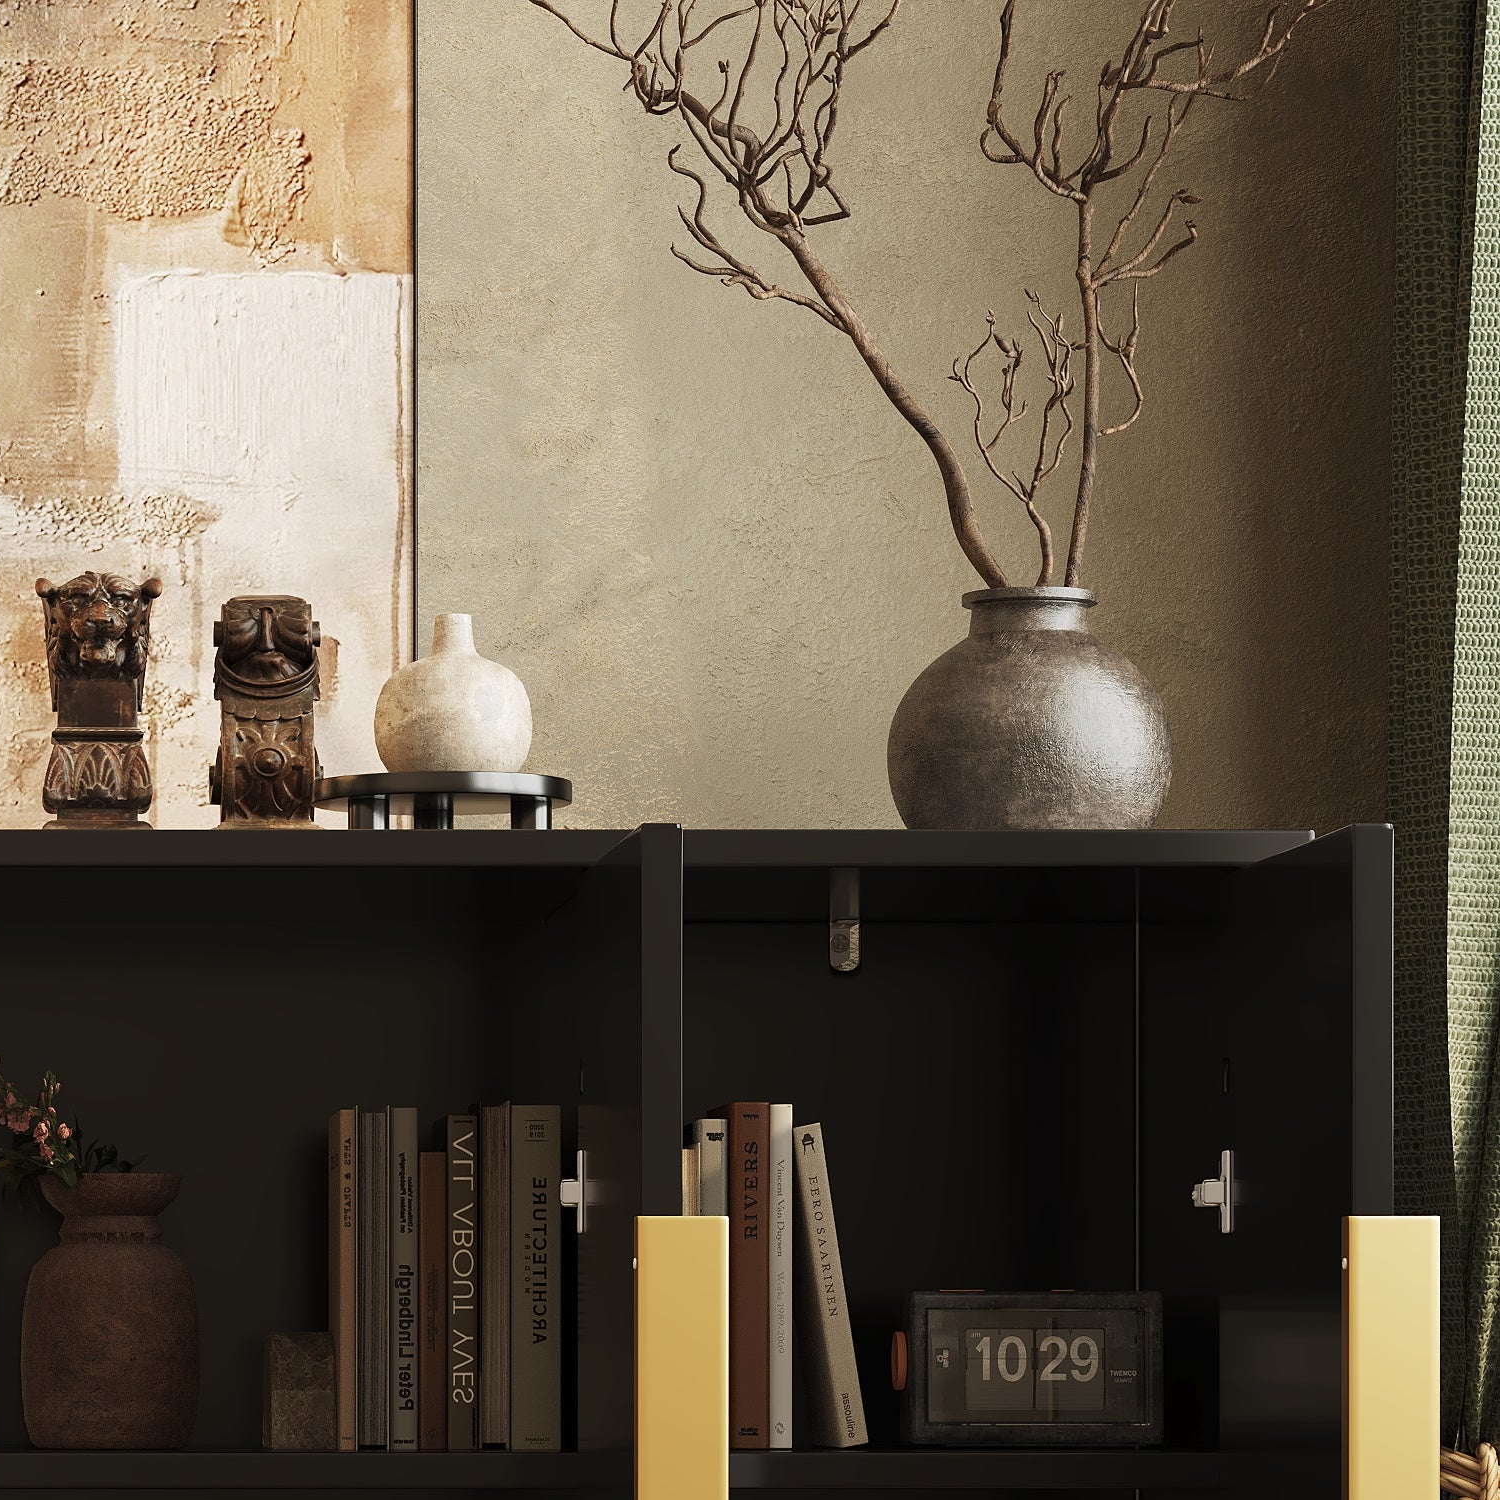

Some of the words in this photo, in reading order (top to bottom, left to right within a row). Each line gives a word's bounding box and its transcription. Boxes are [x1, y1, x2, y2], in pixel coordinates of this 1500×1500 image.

[744, 1141, 758, 1240] RIVERS
[777, 1159, 785, 1196] Vincent
[777, 1199, 785, 1218] Van
[775, 1221, 785, 1257] Duysen
[808, 1175, 824, 1222] EERO
[816, 1227, 838, 1317] SAARINEN
[777, 1271, 785, 1301] Works
[975, 1335, 1027, 1382] 10
[1039, 1335, 1099, 1382] 29
[841, 1392, 856, 1439] assouline
